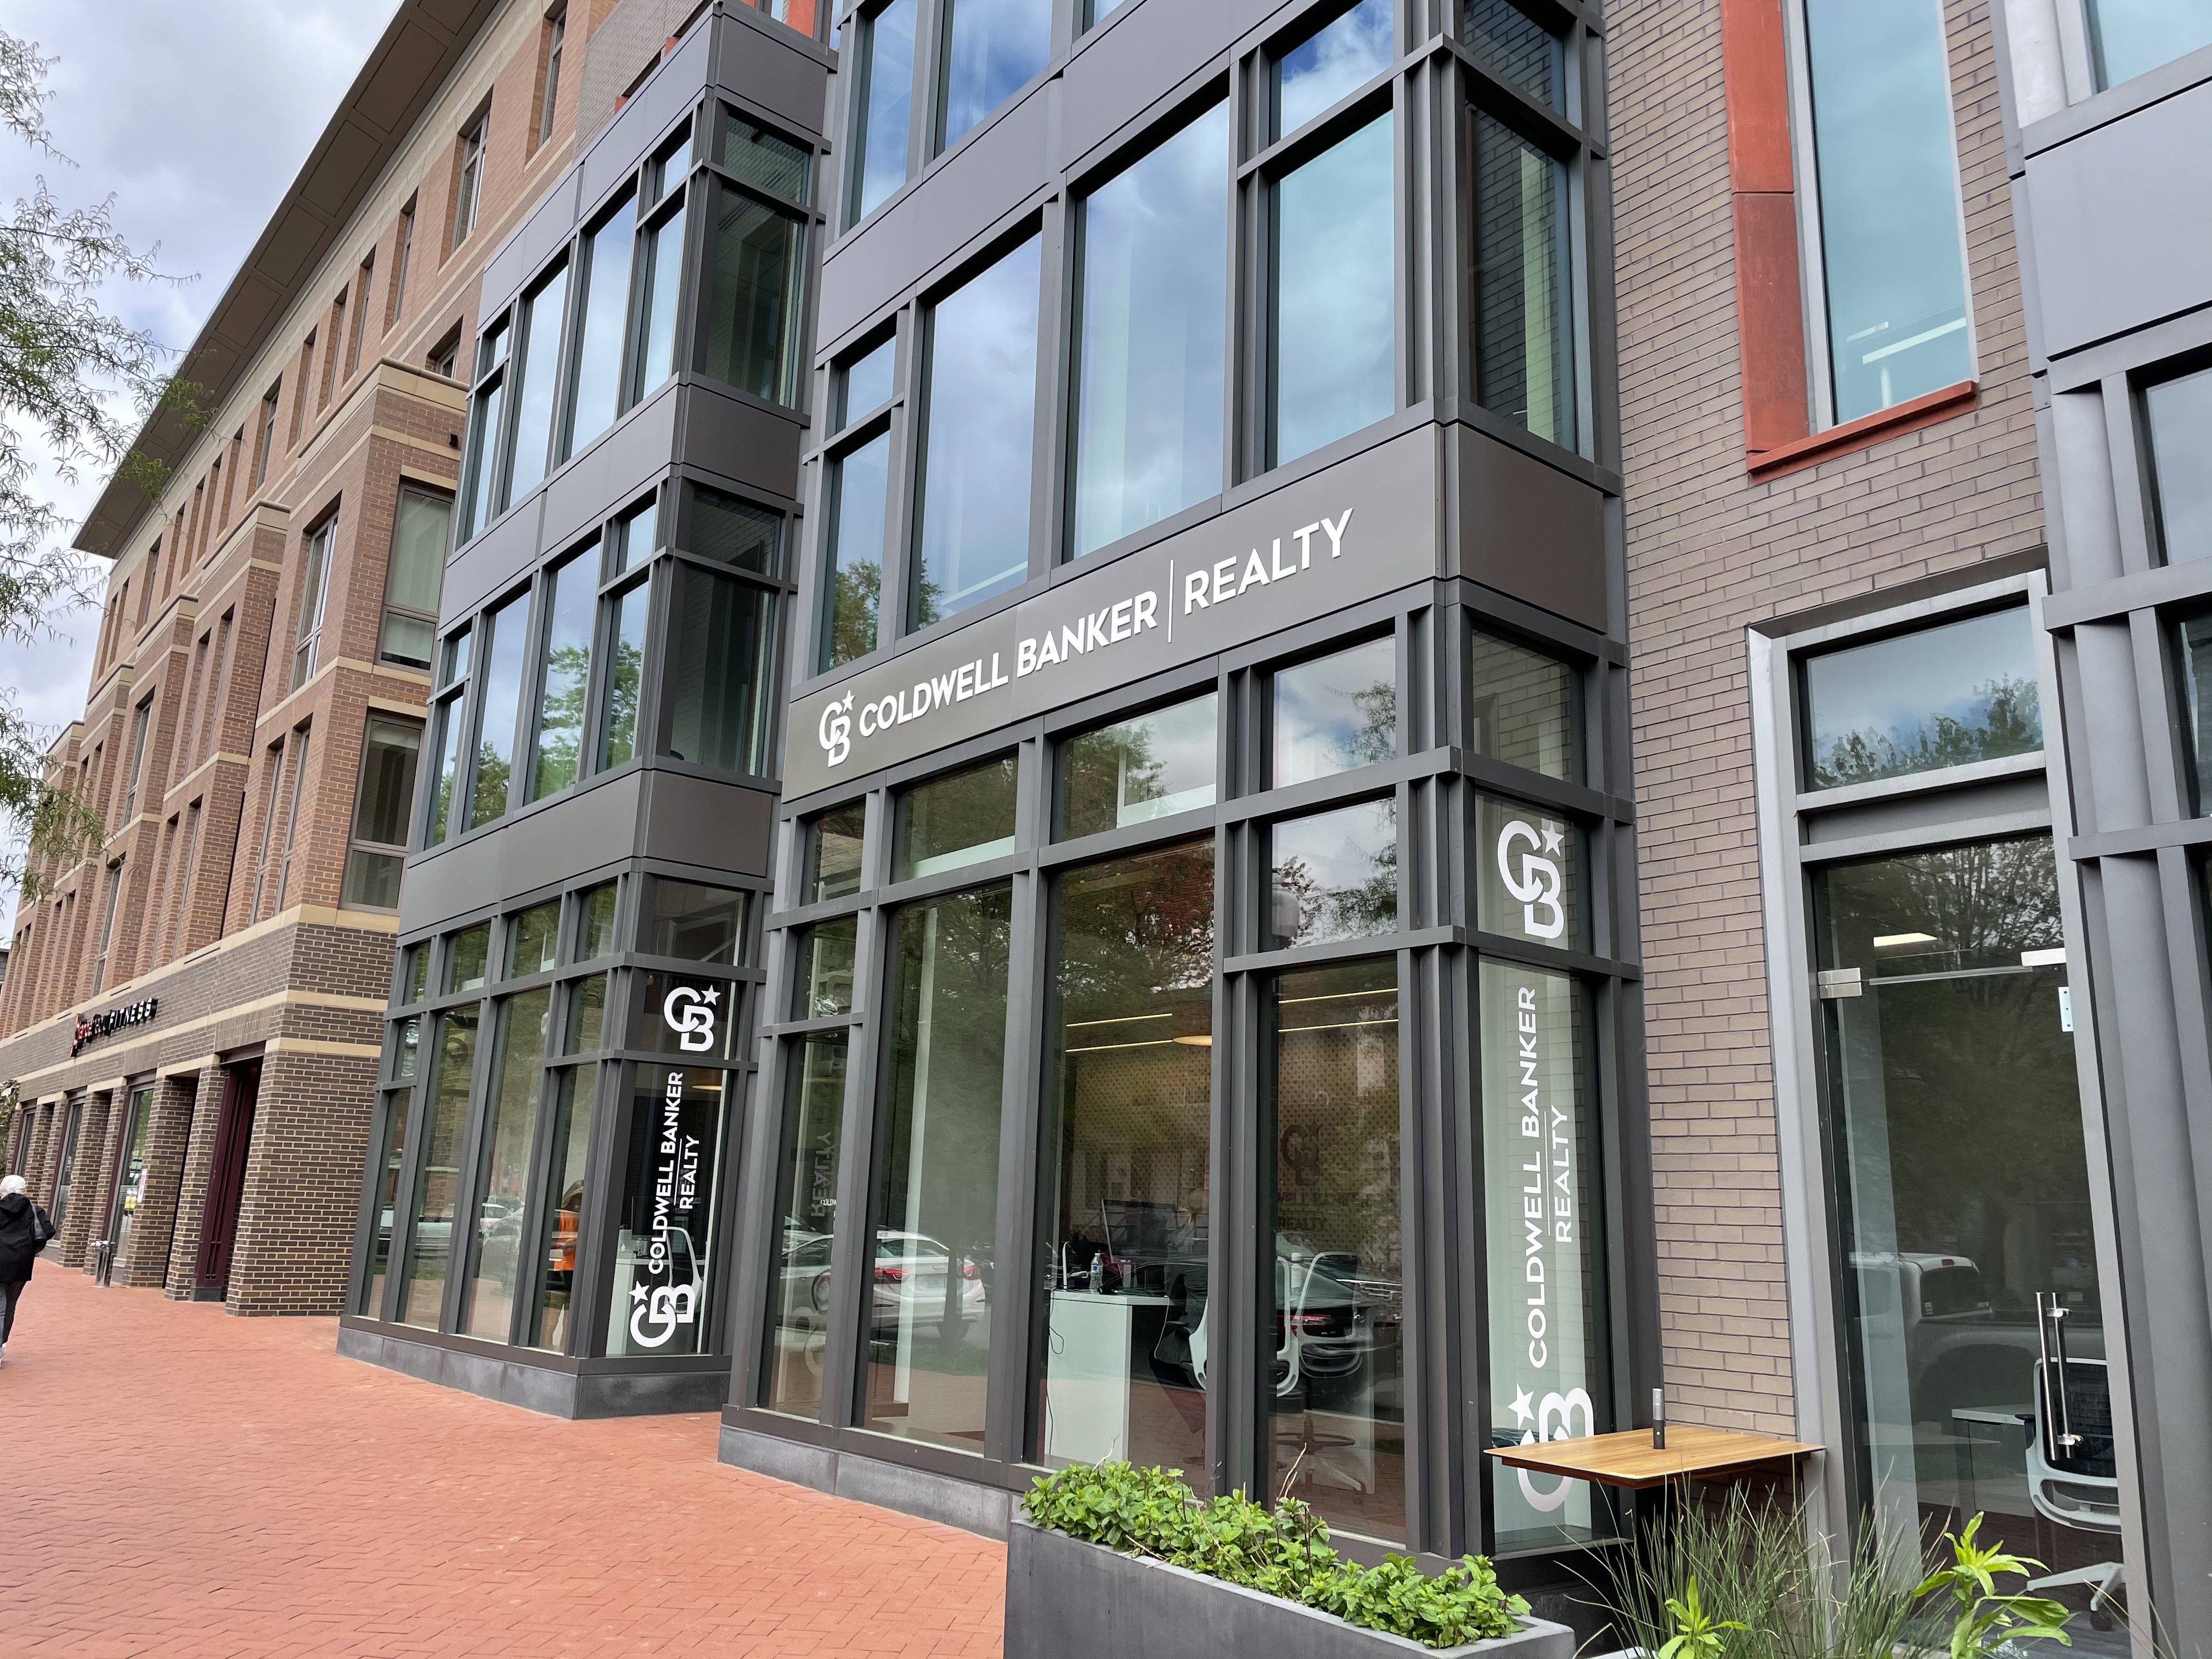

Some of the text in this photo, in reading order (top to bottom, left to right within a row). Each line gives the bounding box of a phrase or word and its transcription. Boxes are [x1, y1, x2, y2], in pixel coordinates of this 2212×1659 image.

[859, 652, 1009, 737] COLDWELL
[1017, 591, 1158, 678] BANKER
[1184, 507, 1353, 616] REALTY
[109, 997, 158, 1030] FITNESS
[1518, 986, 1539, 1138] BANKER
[648, 1160, 674, 1274] COLDWELL
[661, 1071, 684, 1154] BANKER
[679, 1135, 699, 1209] REALTY
[1551, 1104, 1572, 1243] REALTY
[1523, 1151, 1548, 1369] COLDWELL
